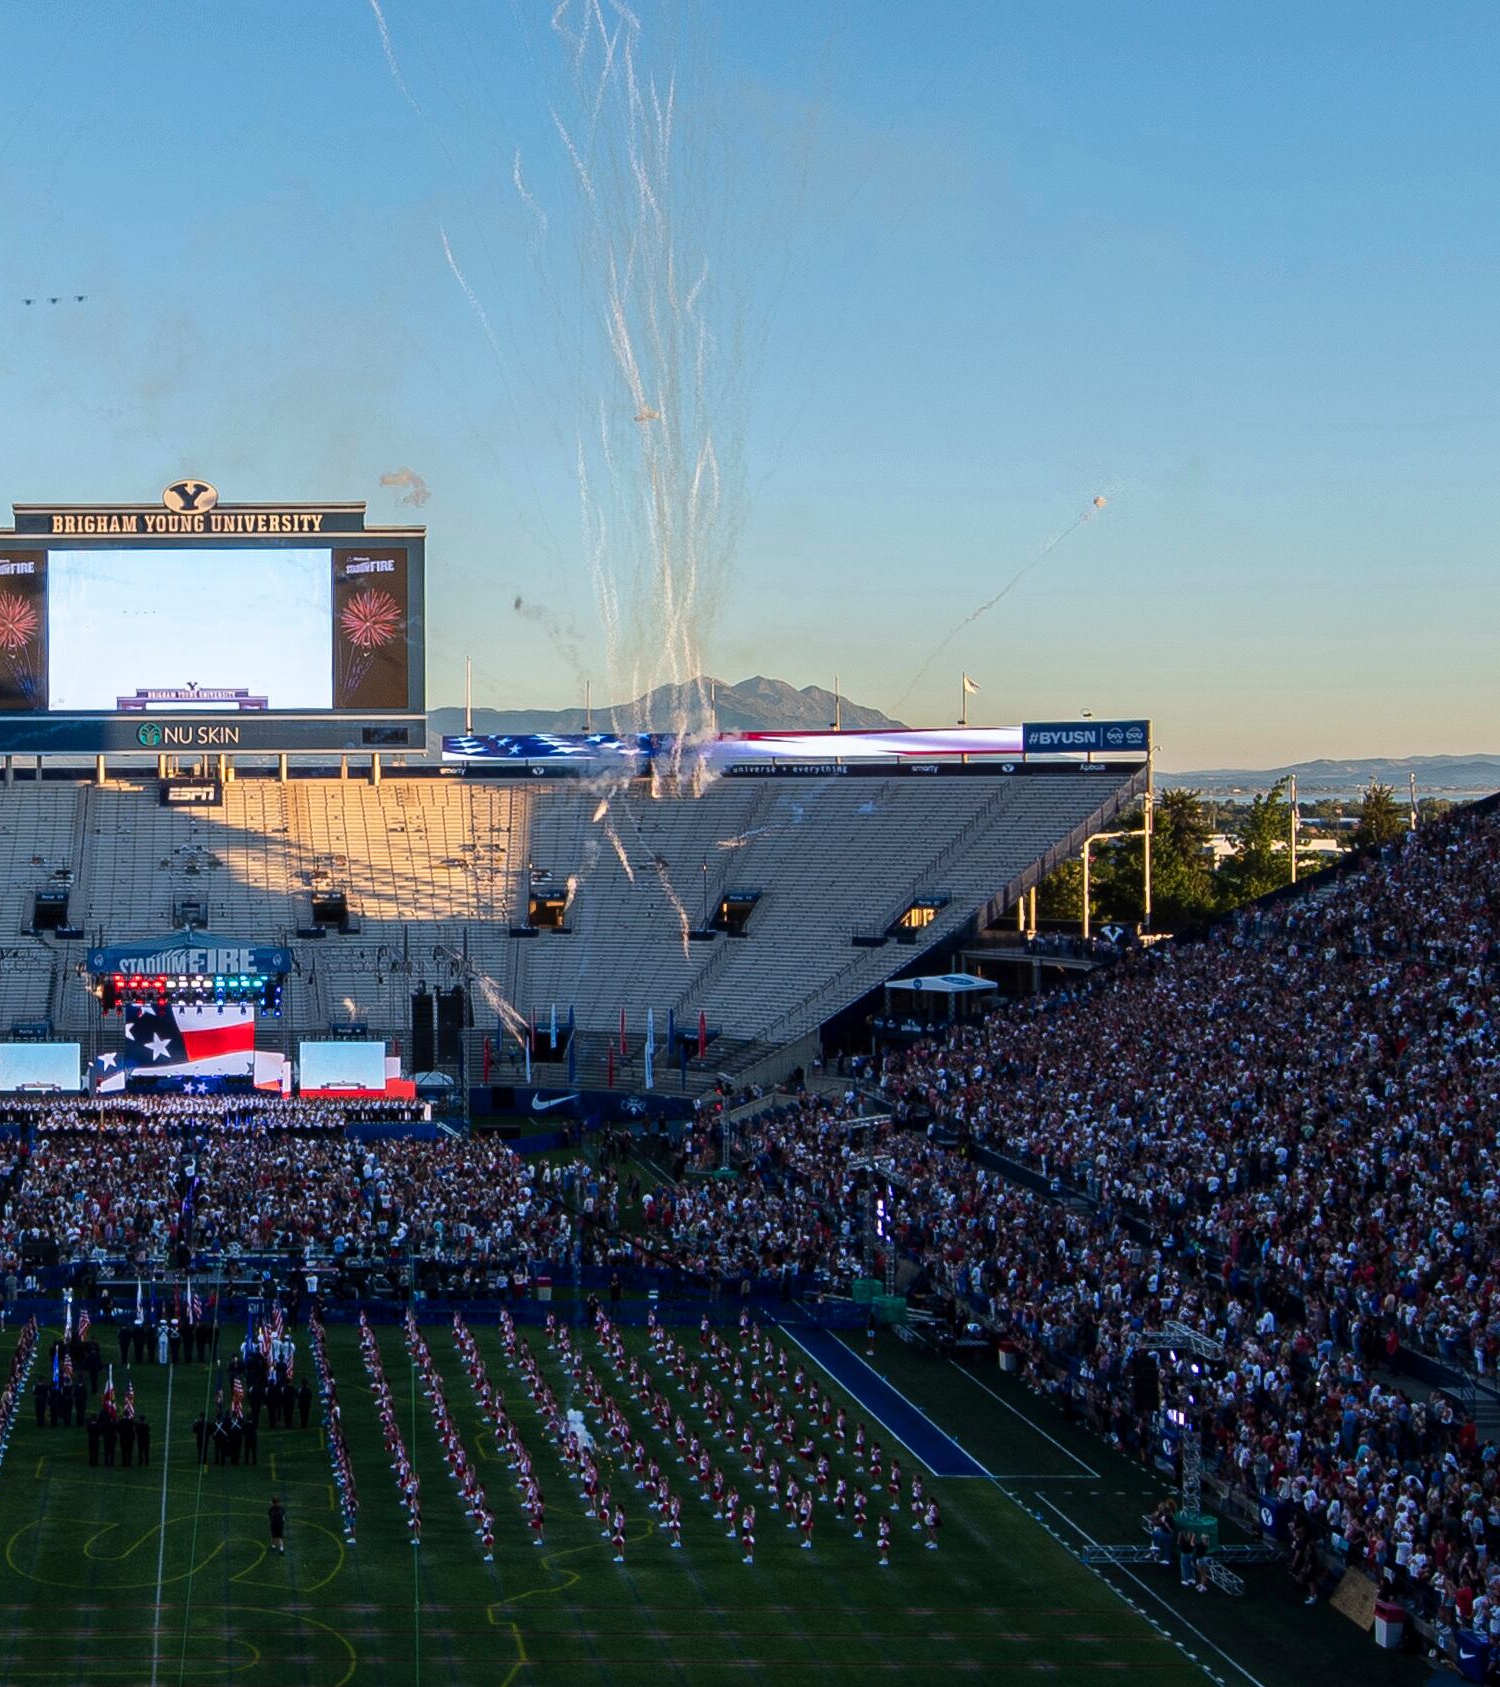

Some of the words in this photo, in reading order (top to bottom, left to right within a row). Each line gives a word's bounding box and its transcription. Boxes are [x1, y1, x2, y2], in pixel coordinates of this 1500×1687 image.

[169, 482, 207, 511] Y
[52, 515, 137, 533] BRIGHAM
[144, 514, 204, 533] YOUNG
[210, 514, 323, 532] UNIVERSITY
[164, 727, 193, 745] NU
[197, 726, 239, 744] SKIN
[1028, 730, 1096, 745] #BYUSN
[792, 765, 848, 775] everything
[168, 786, 215, 801] ESPN
[188, 949, 258, 974] FIRE
